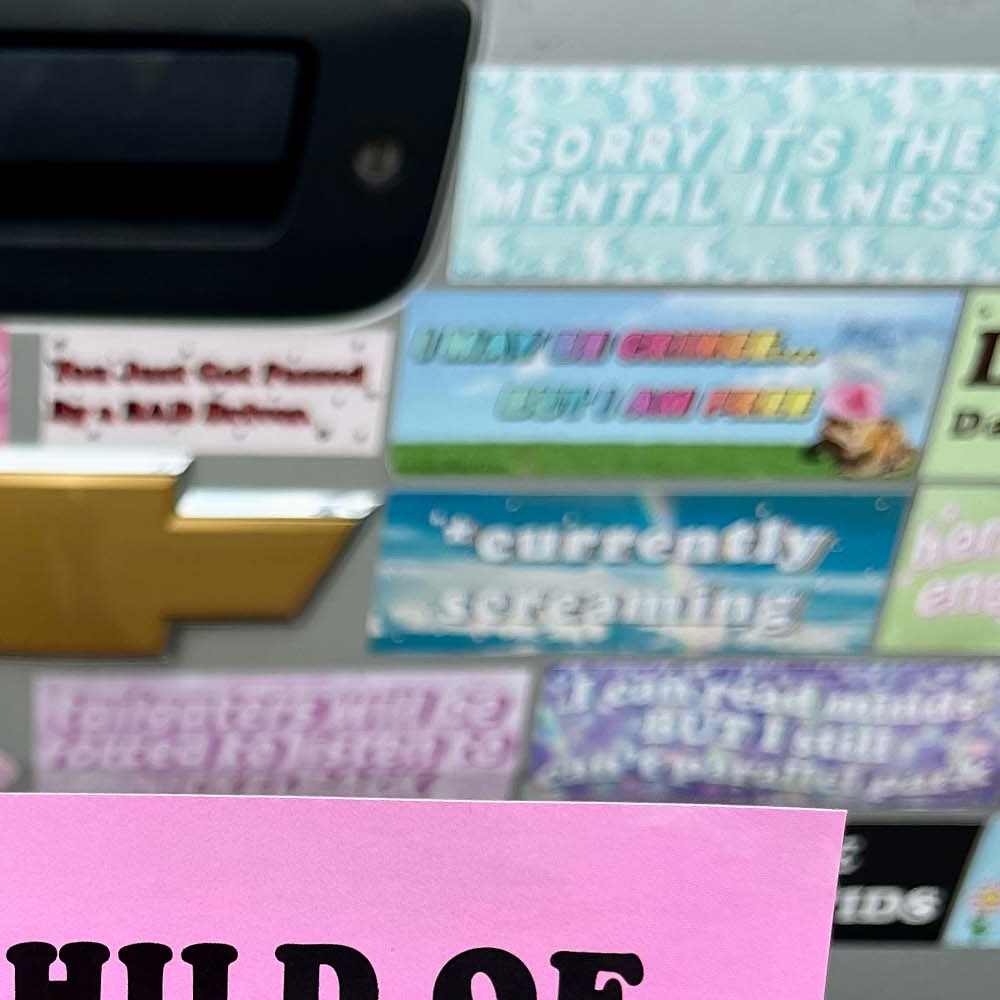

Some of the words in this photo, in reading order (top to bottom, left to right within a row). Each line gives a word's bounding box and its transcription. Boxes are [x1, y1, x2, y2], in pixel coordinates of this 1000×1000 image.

[505, 122, 712, 172] SORRY
[875, 125, 990, 174] THE
[475, 174, 720, 225] MENTAL
[745, 176, 1000, 226] ILLNESS
[435, 584, 804, 638] screaming
